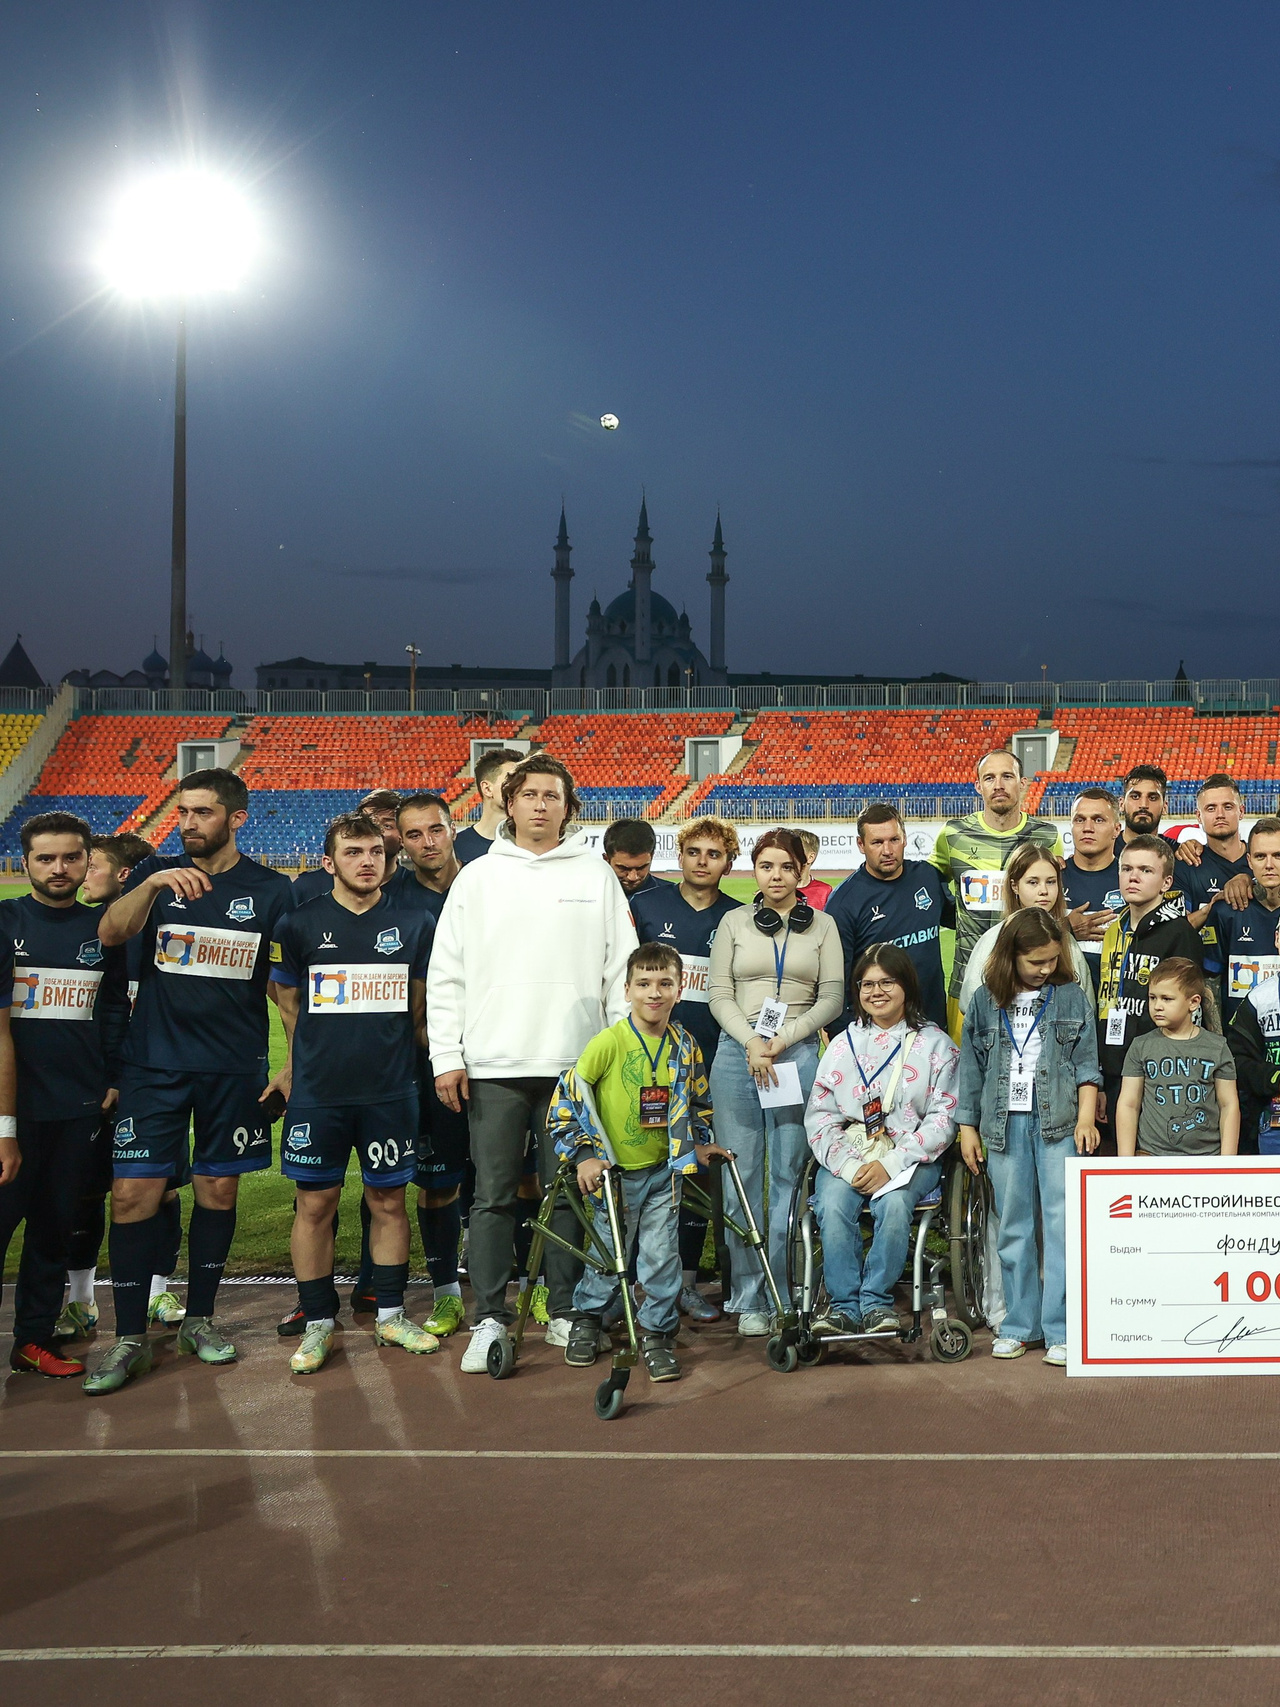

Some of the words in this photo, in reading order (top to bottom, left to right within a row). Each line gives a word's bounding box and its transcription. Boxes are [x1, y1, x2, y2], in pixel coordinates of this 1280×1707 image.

[199, 936, 231, 946] ПОБЕЖДАЕМ
[196, 944, 257, 968] ВМЕСТЕ
[44, 977, 77, 986] ПОБЕЖДАЕМ
[352, 981, 406, 1001] ВМЕСТЕ
[42, 986, 97, 1009] ВМЕСТЕ
[1145, 1056, 1215, 1080] DON'T
[232, 1126, 249, 1156] 9
[367, 1138, 399, 1169] 90
[1138, 1211, 1251, 1219] ИНВЕСТИЦИОННО-СТРОИТЕЛЬНАЯ
[1110, 1245, 1142, 1254] Выдан
[1216, 1234, 1280, 1256] фонду
[1213, 1271, 1229, 1302] 1
[1110, 1297, 1124, 1306] На
[1126, 1297, 1157, 1307] сумму
[1110, 1333, 1153, 1343] Подпись
